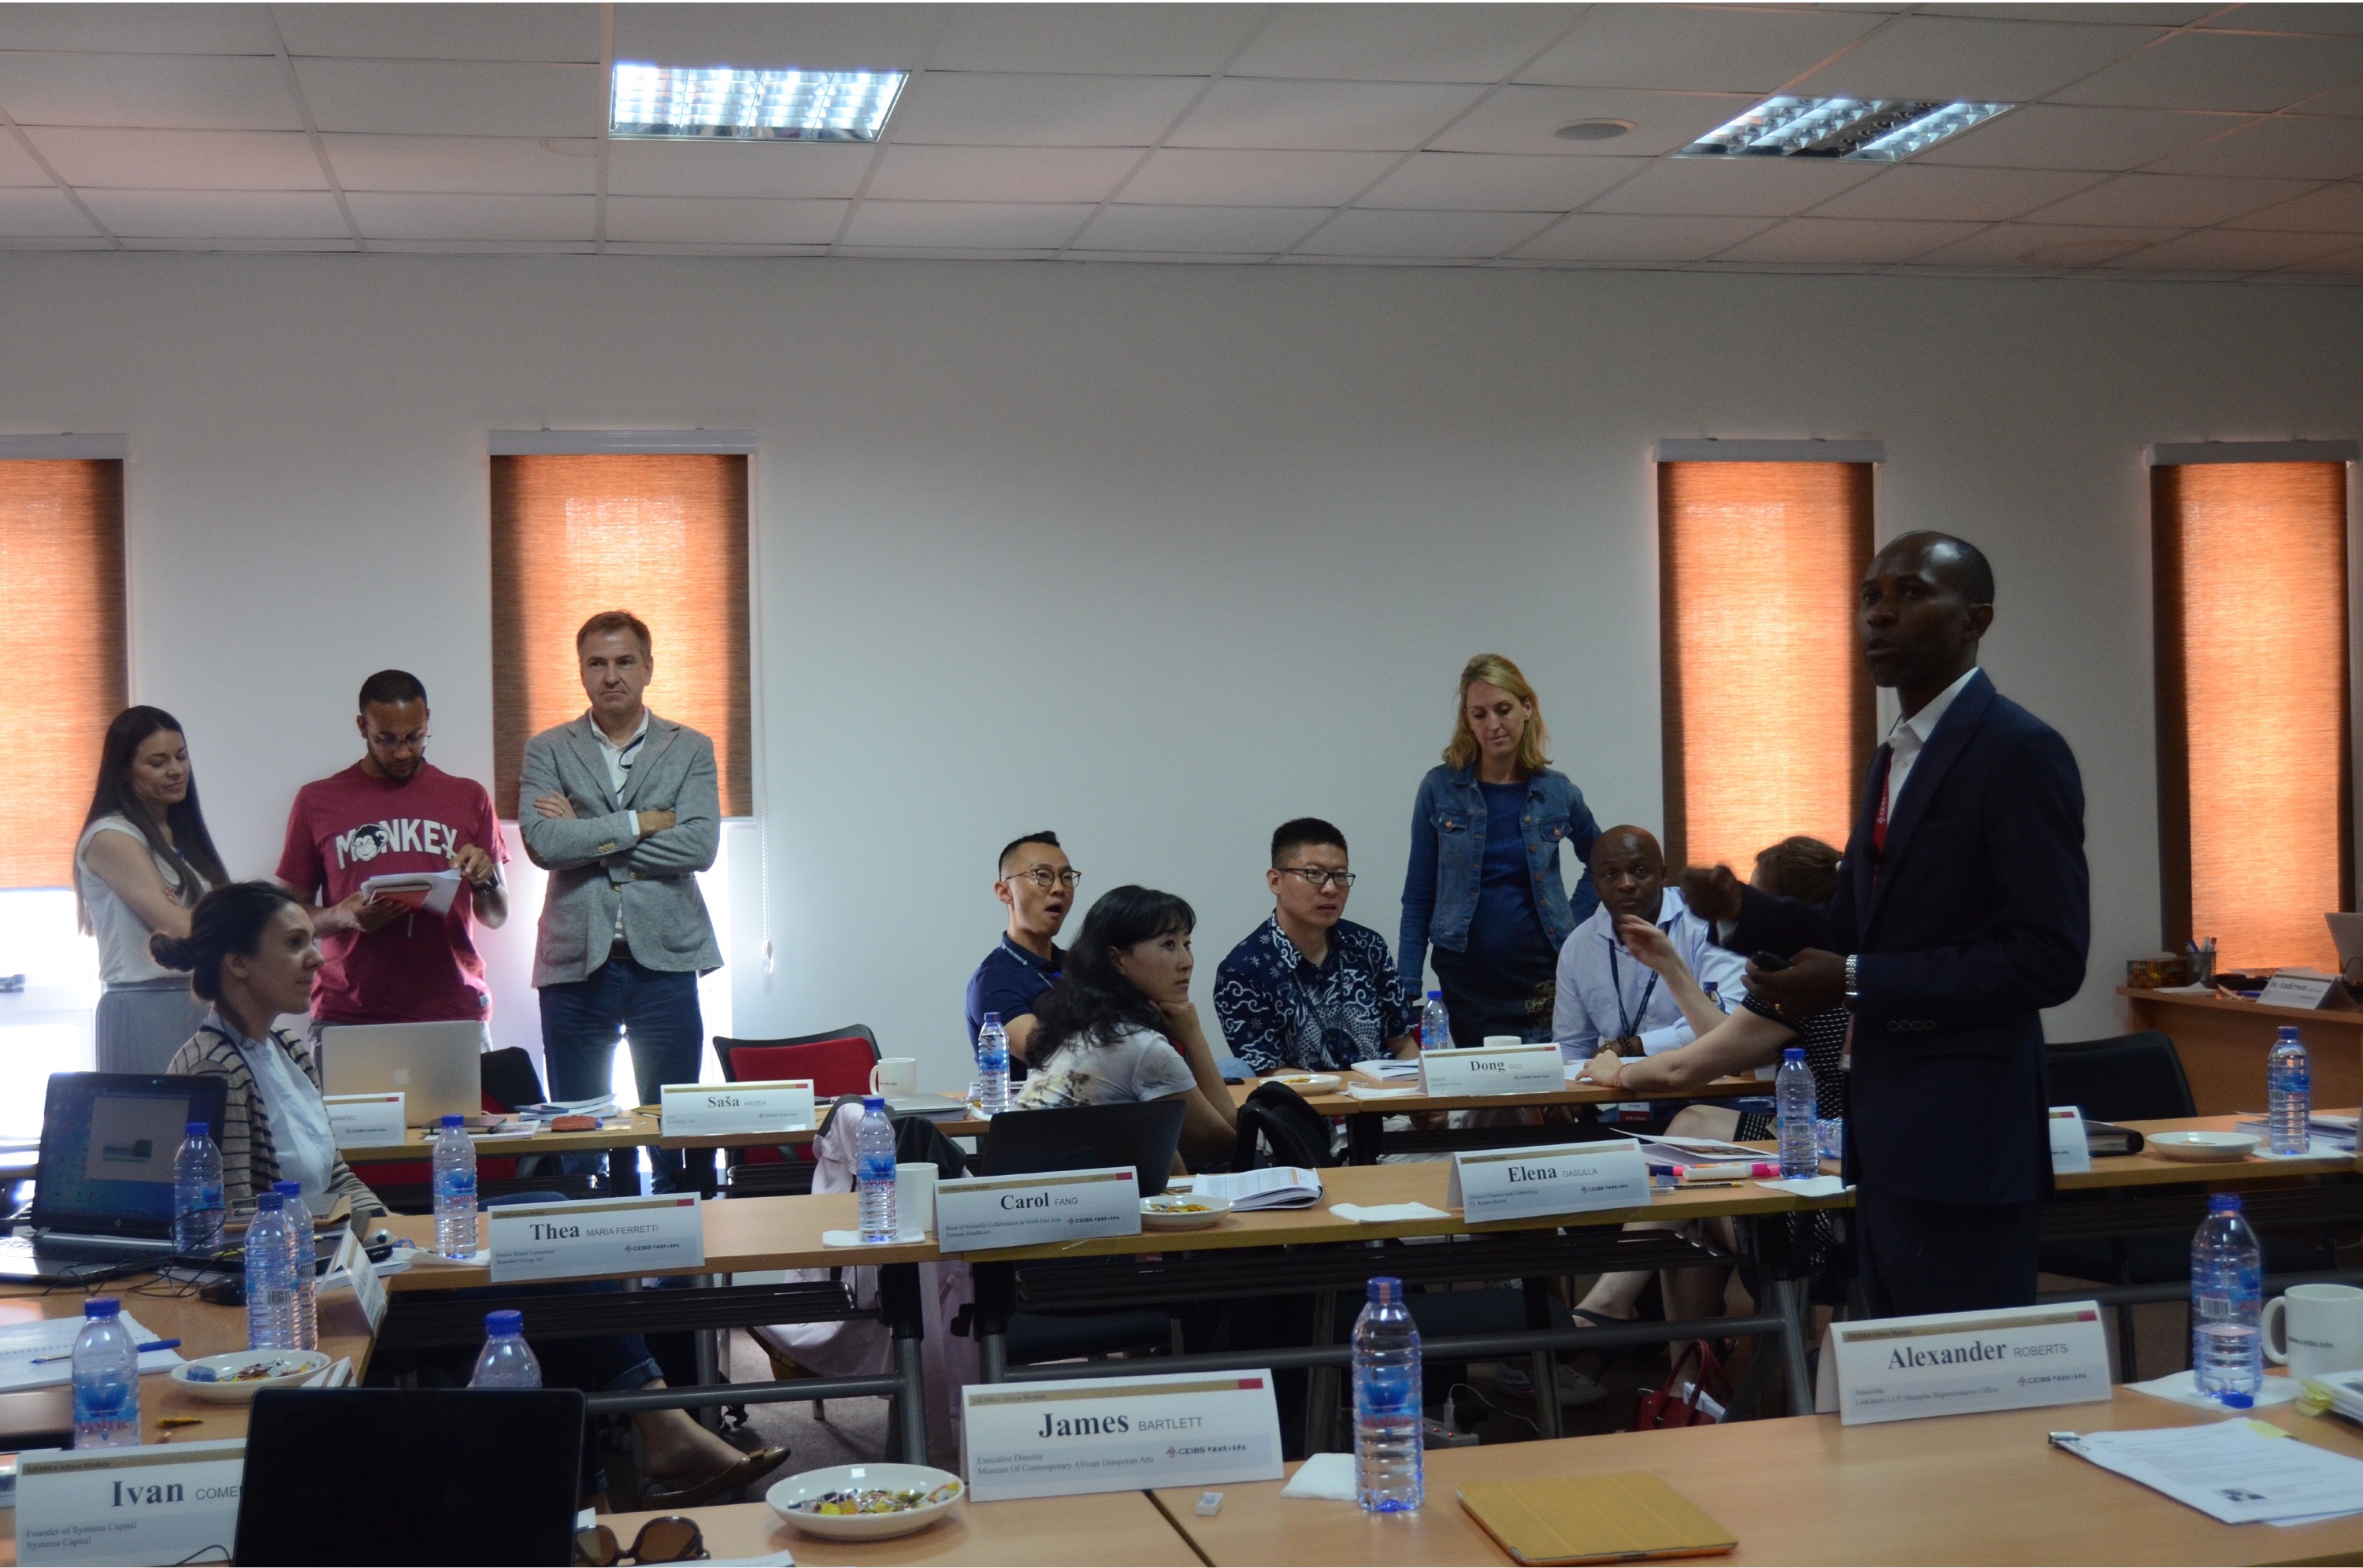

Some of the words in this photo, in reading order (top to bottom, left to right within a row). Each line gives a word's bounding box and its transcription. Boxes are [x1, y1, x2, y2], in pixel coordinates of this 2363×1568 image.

[1471, 1061, 1505, 1072] Dong
[708, 1095, 740, 1108] Saša
[1508, 1166, 1557, 1182] Elena
[1563, 1168, 1598, 1177] GASULLA
[1000, 1192, 1049, 1210] Carol
[1055, 1197, 1078, 1206] FANG
[530, 1224, 580, 1240] Thea
[586, 1227, 614, 1236] MARIA
[616, 1225, 658, 1235] FERRETTI
[1888, 1340, 2007, 1369] Alexander
[2013, 1344, 2068, 1358] ROBERTS
[1904, 1392, 1931, 1402] Shanghai
[1933, 1389, 1977, 1399] Representative
[1038, 1413, 1130, 1438] James
[1138, 1417, 1204, 1432] BARTLETT
[977, 1455, 1013, 1465] Executive
[1015, 1452, 1043, 1462] Director
[977, 1465, 1008, 1475] Museum
[1010, 1464, 1021, 1473] Of
[1022, 1461, 1072, 1473] Contemporary
[1074, 1458, 1100, 1468] African
[1102, 1456, 1137, 1467] Diasporan
[1140, 1455, 1155, 1464] Arts
[111, 1481, 184, 1507] Ivan
[195, 1485, 242, 1499] COME
[27, 1528, 60, 1538] Founder
[61, 1526, 71, 1536] of
[72, 1525, 106, 1536] Systema
[109, 1522, 137, 1533] Capital
[27, 1540, 60, 1550] Systema
[63, 1537, 91, 1548] Capital
